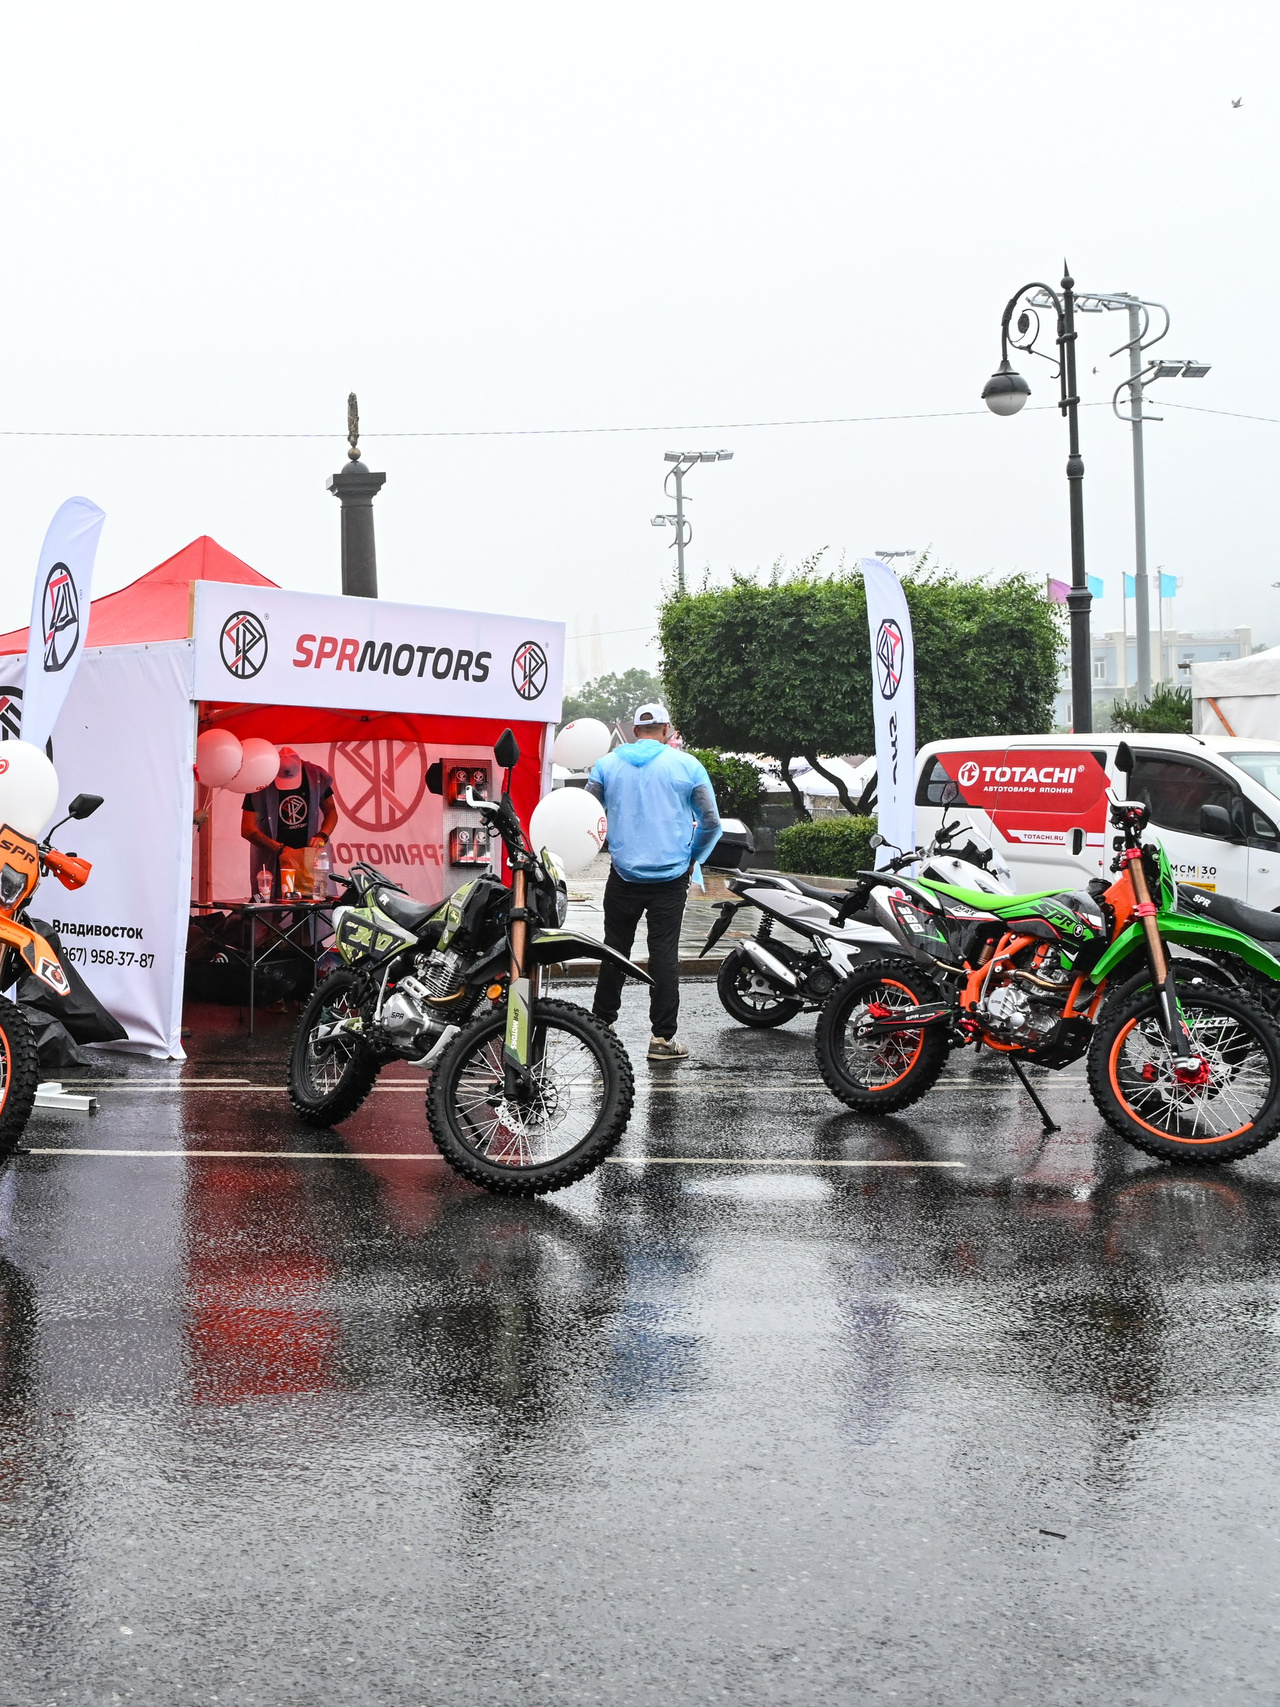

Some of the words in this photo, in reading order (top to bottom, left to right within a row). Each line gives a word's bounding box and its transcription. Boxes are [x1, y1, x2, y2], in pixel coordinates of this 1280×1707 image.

[292, 634, 492, 683] SPRMOTORS
[982, 767, 1077, 783] TOTACHI
[1201, 866, 1217, 875] 30
[1193, 894, 1211, 907] SPR
[52, 919, 144, 940] Владивосток
[90, 949, 155, 969] 958-37-87
[391, 1011, 405, 1020] SPR
[905, 1013, 919, 1021] SPR
